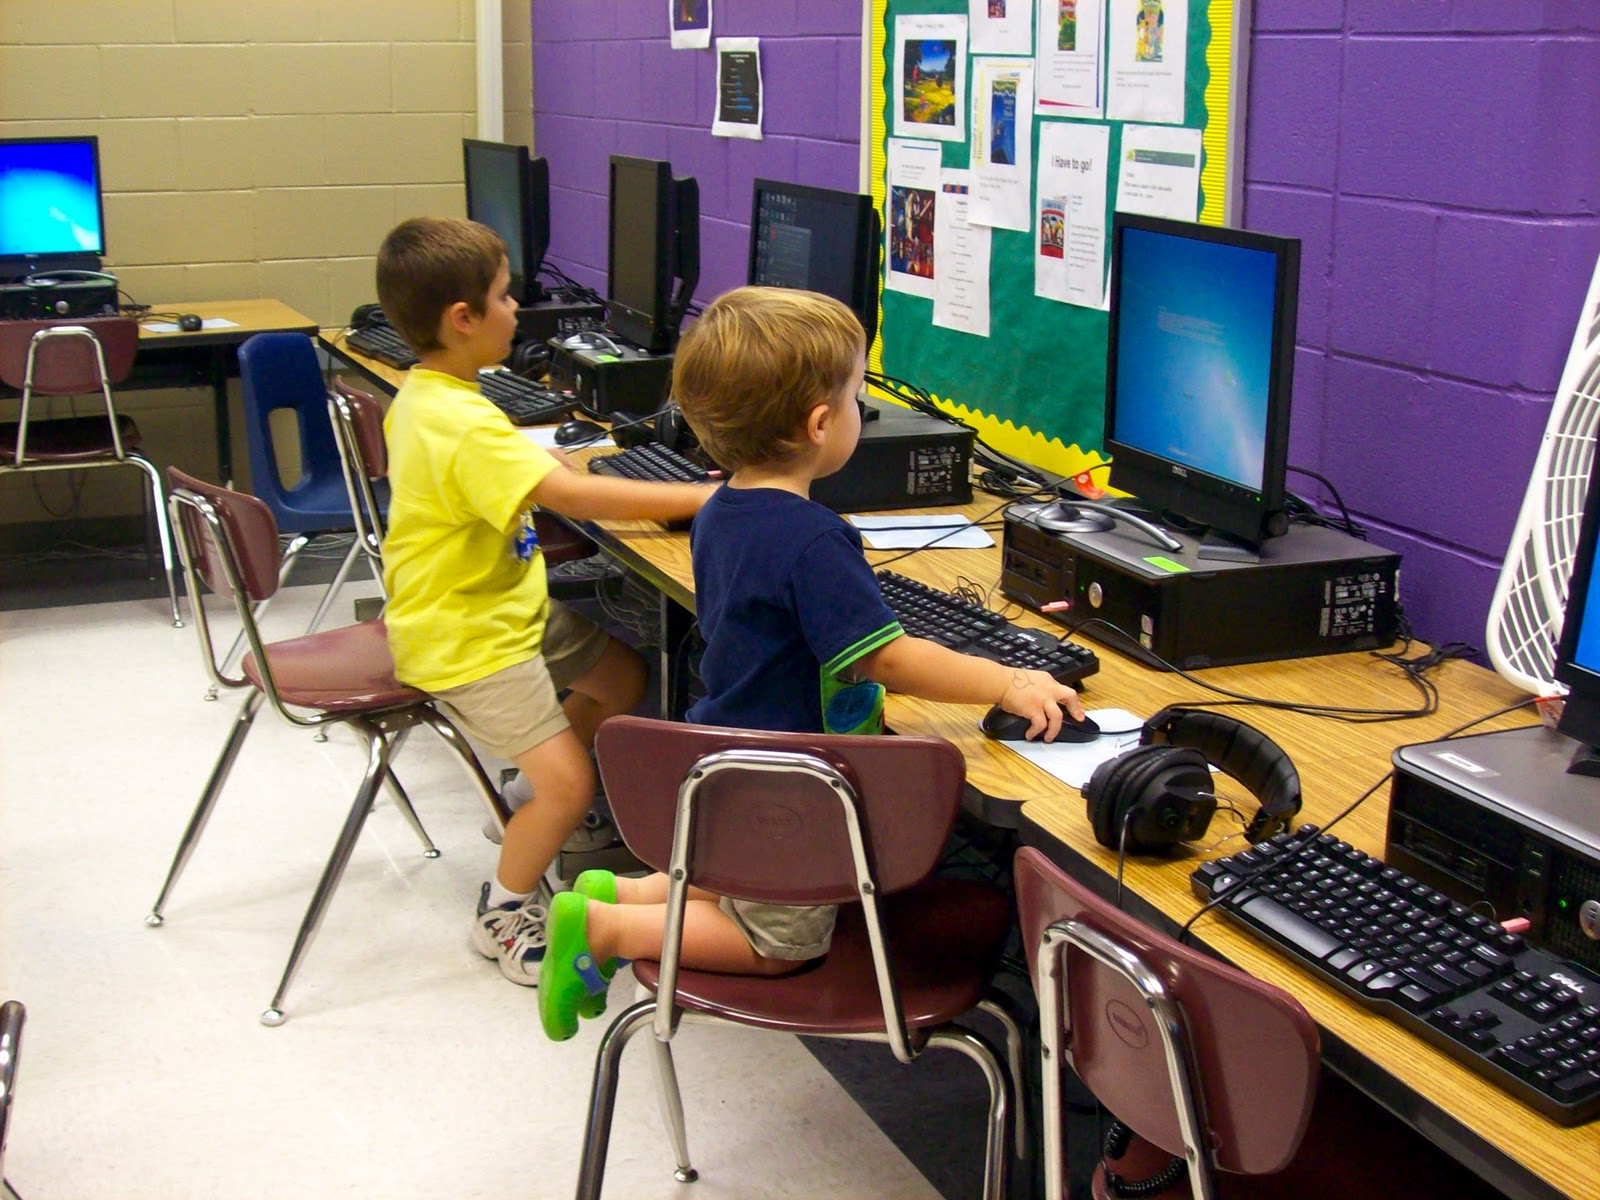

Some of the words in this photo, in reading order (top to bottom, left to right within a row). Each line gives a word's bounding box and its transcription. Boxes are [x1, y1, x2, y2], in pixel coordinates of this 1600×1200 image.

[1055, 155, 1071, 168] Have
[1071, 157, 1079, 170] to
[1080, 158, 1093, 174] go!
[1549, 972, 1586, 993] DELL
